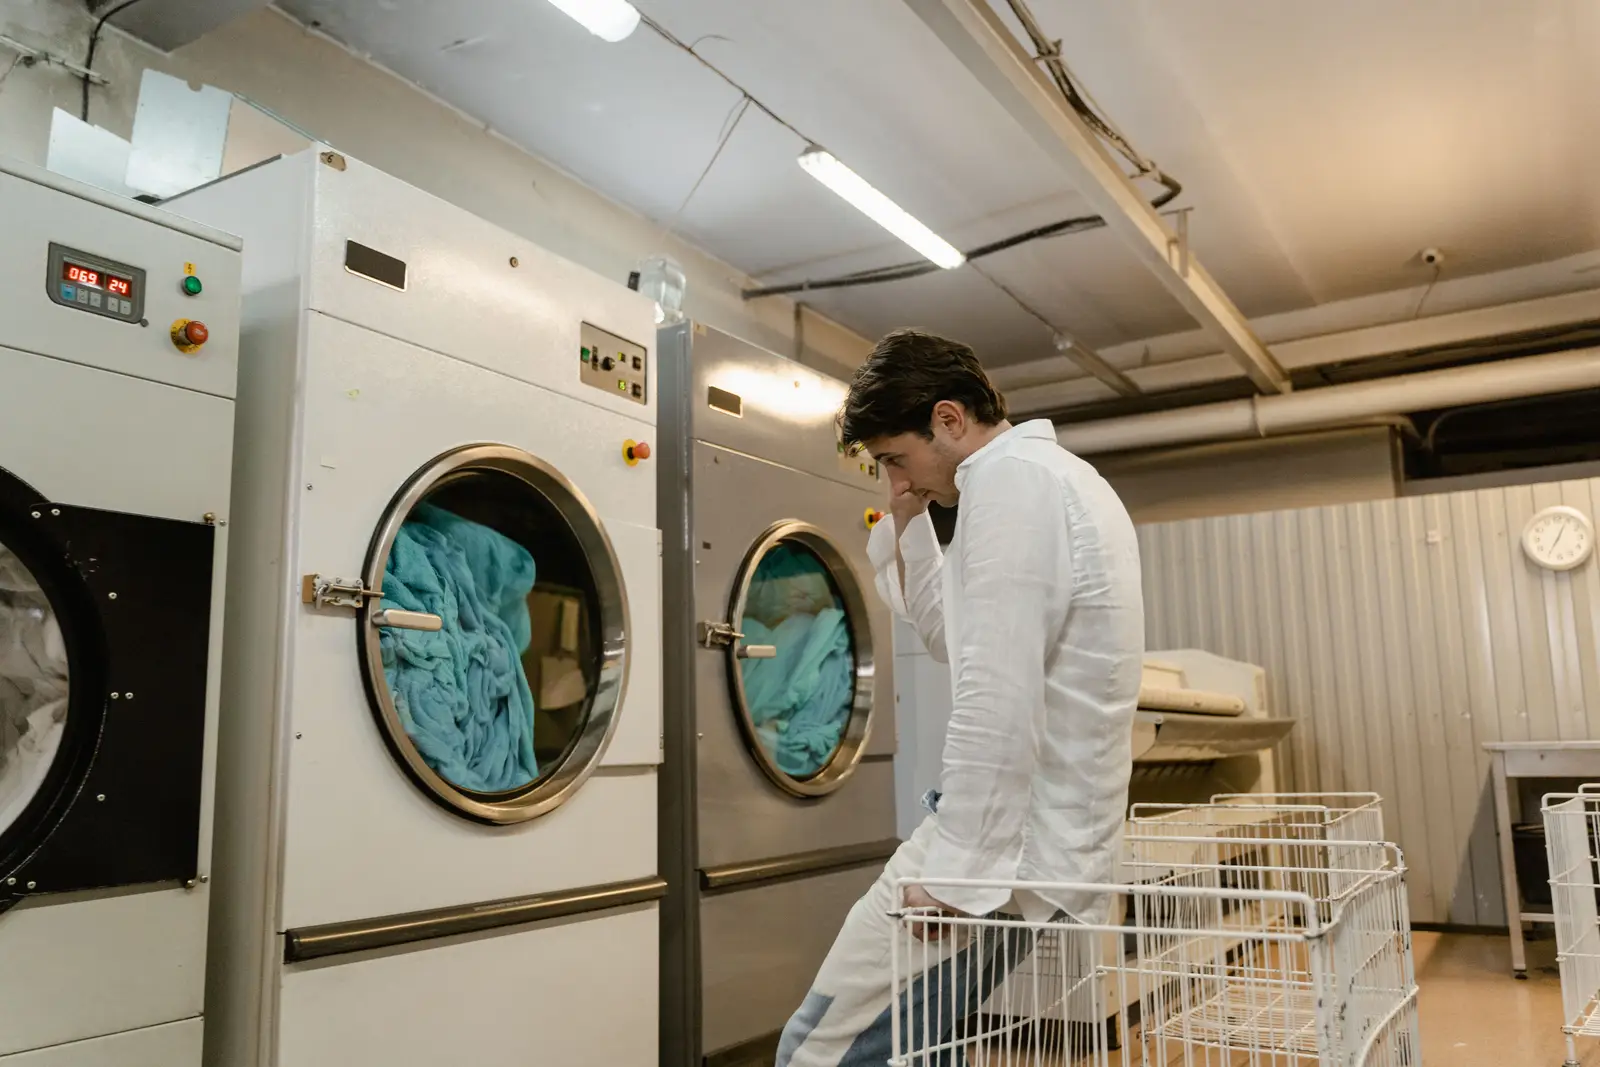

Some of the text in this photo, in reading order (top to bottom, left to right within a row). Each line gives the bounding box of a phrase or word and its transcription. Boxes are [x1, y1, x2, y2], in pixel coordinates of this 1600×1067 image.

[327, 154, 334, 163] 6
[68, 267, 129, 294] 069 24
